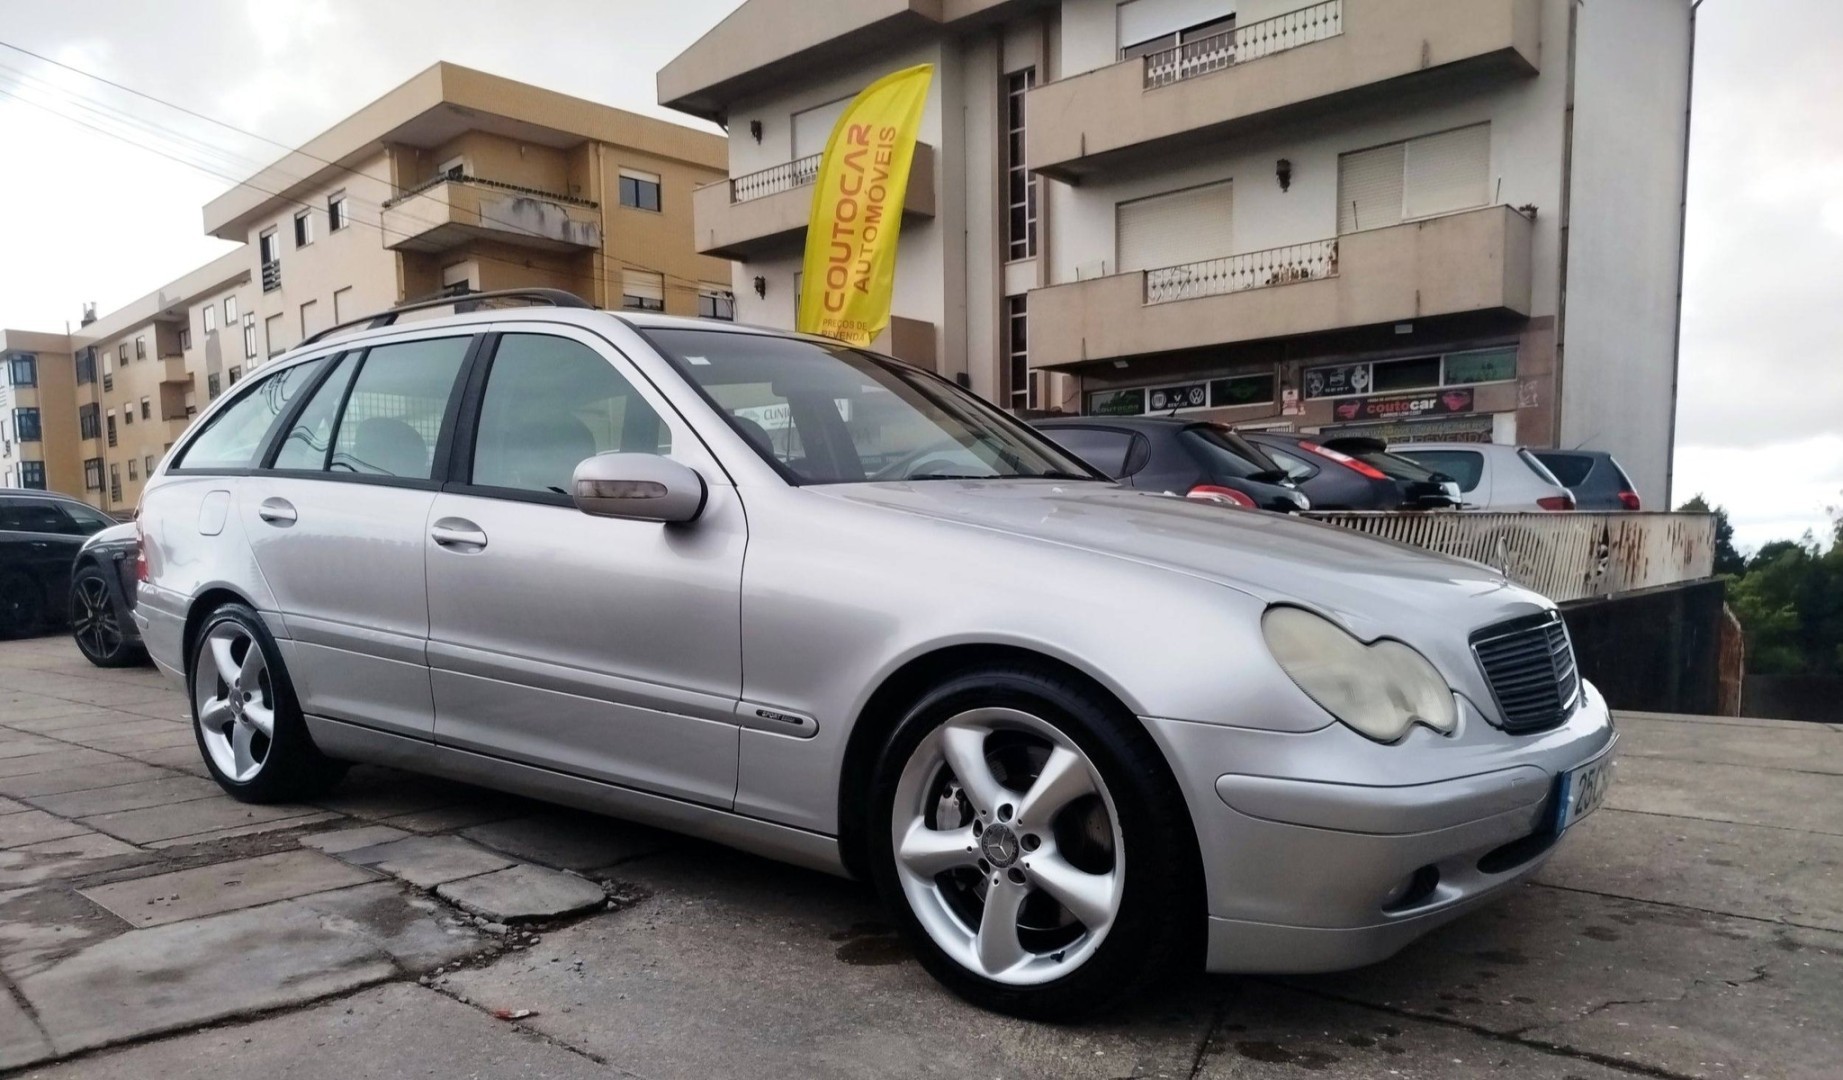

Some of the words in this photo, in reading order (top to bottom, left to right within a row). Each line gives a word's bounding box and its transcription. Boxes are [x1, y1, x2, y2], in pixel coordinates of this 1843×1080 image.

[853, 125, 897, 294] AUTOMÓVEIS
[824, 123, 873, 313] COUTOCAR
[822, 318, 855, 329] PREÇOS
[856, 320, 868, 331] DE
[821, 329, 865, 342] REVENDA
[1366, 399, 1437, 414] coutocar
